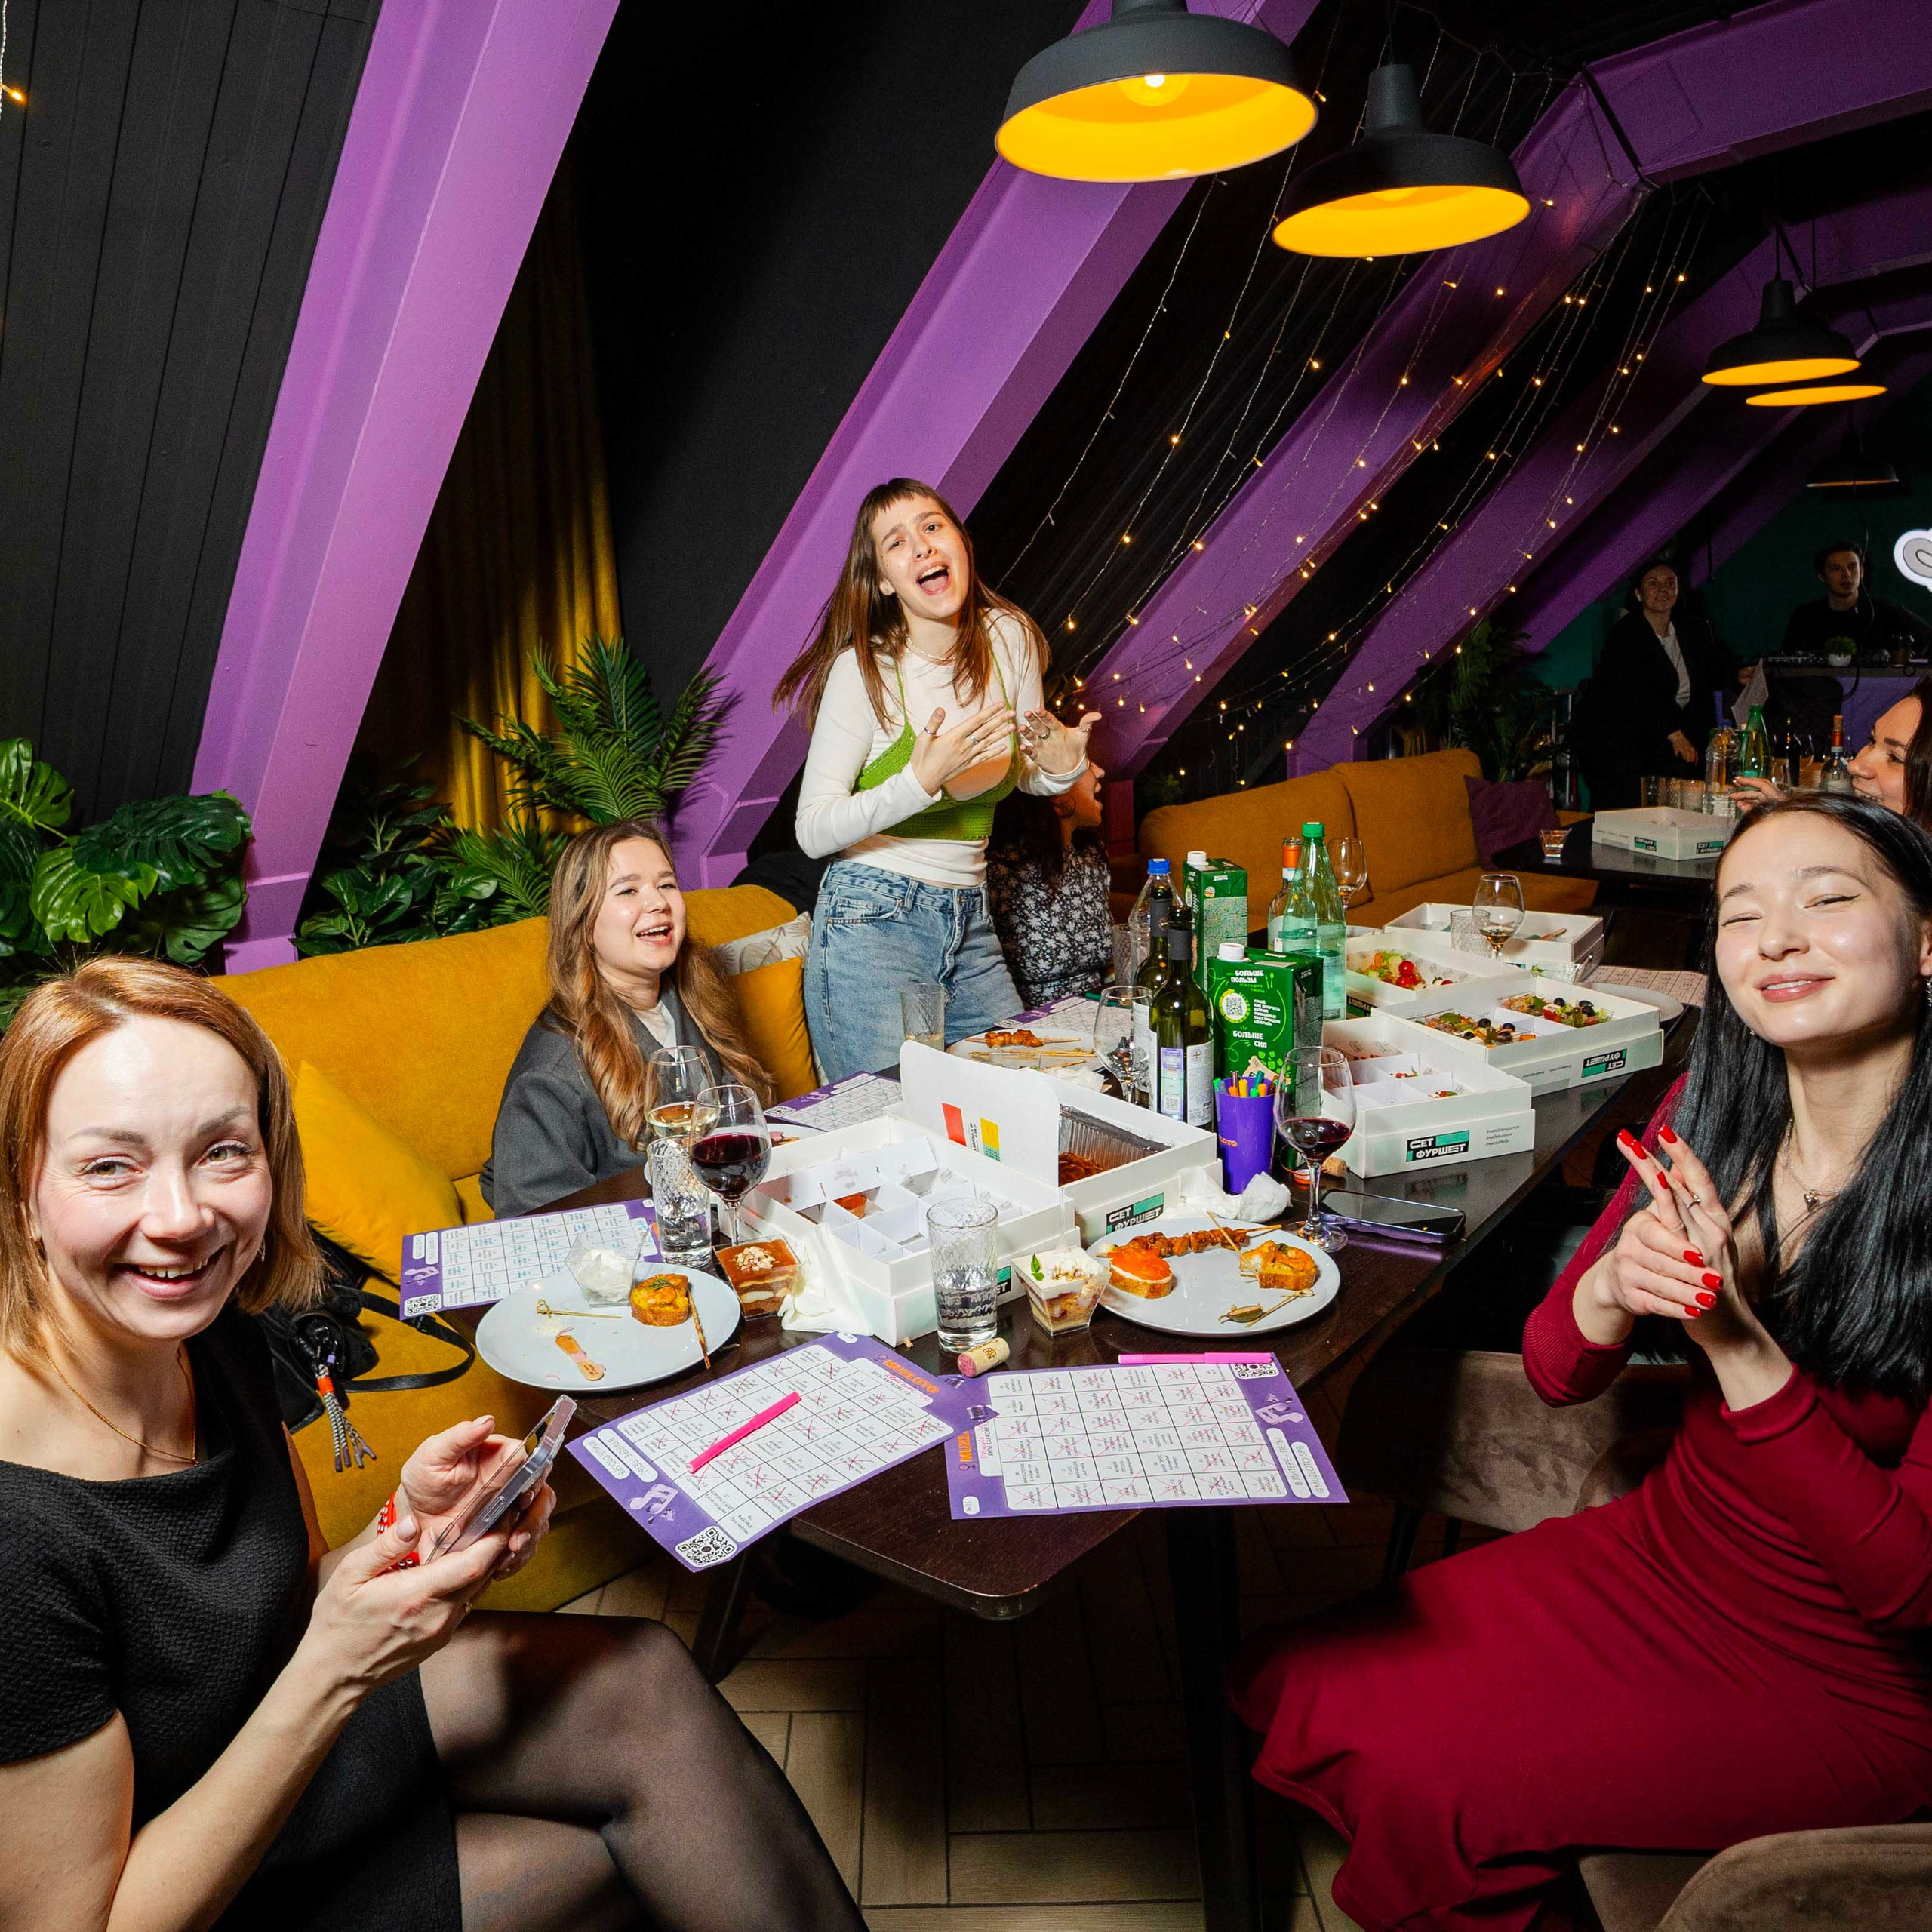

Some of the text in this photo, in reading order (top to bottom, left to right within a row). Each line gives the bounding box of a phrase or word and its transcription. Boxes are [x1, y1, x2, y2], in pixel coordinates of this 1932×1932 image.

[1232, 1030, 1264, 1040] БОЛЬШЕ
[1585, 1052, 1621, 1066] ФУРШЕТ
[1607, 1060, 1624, 1070] СЕТ
[1409, 1137, 1434, 1149] СЕТ
[1415, 1143, 1466, 1158] ФУРШЕТ
[1109, 1208, 1131, 1223] СЕТ
[1115, 1208, 1161, 1231] ФУРШЕТ
[883, 1359, 940, 1394] MUZLOTO
[611, 1441, 632, 1460] ПИТЕРЕ
[957, 1430, 973, 1463] MUZL
[1284, 1457, 1300, 1480] ПИТЕРЕ
[1296, 1446, 1324, 1493] @MUZLOTO.SPB
